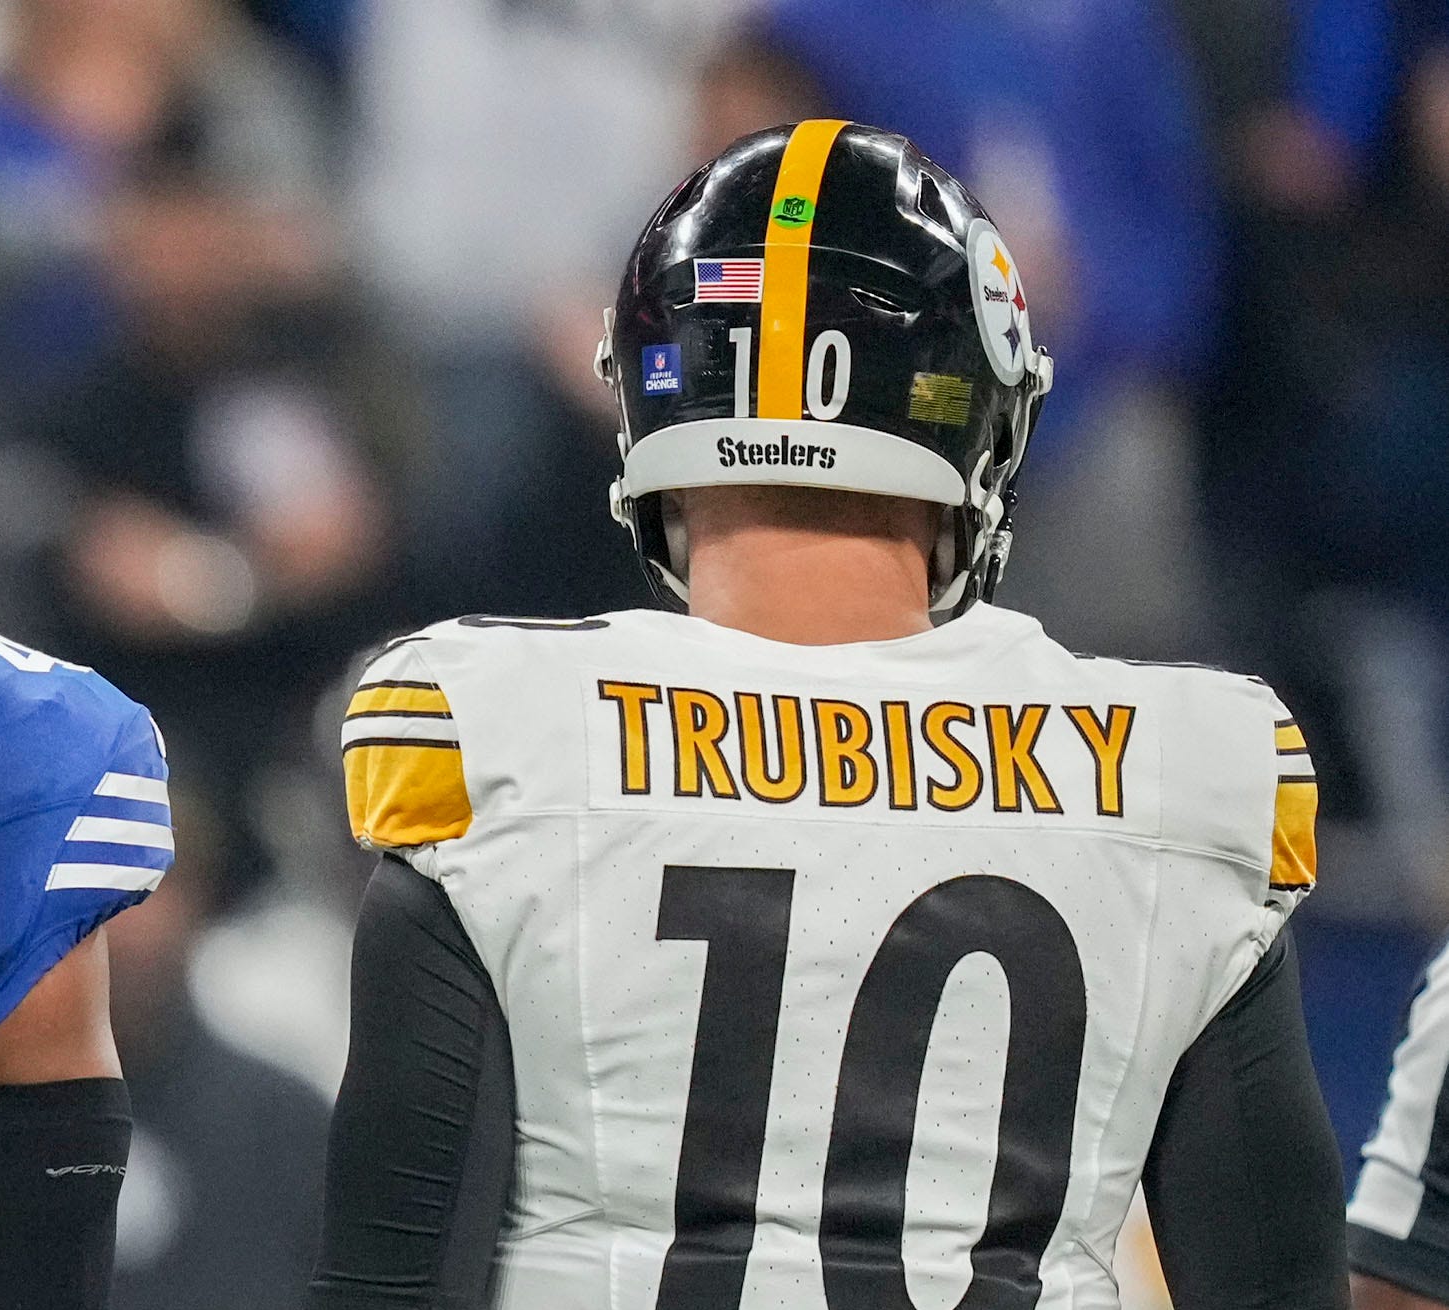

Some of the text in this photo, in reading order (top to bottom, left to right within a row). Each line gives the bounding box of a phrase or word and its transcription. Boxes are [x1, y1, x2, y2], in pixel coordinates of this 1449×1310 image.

[646, 378, 679, 391] CHANGE
[716, 435, 837, 469] Steelers
[598, 680, 1136, 816] TRUBISKY
